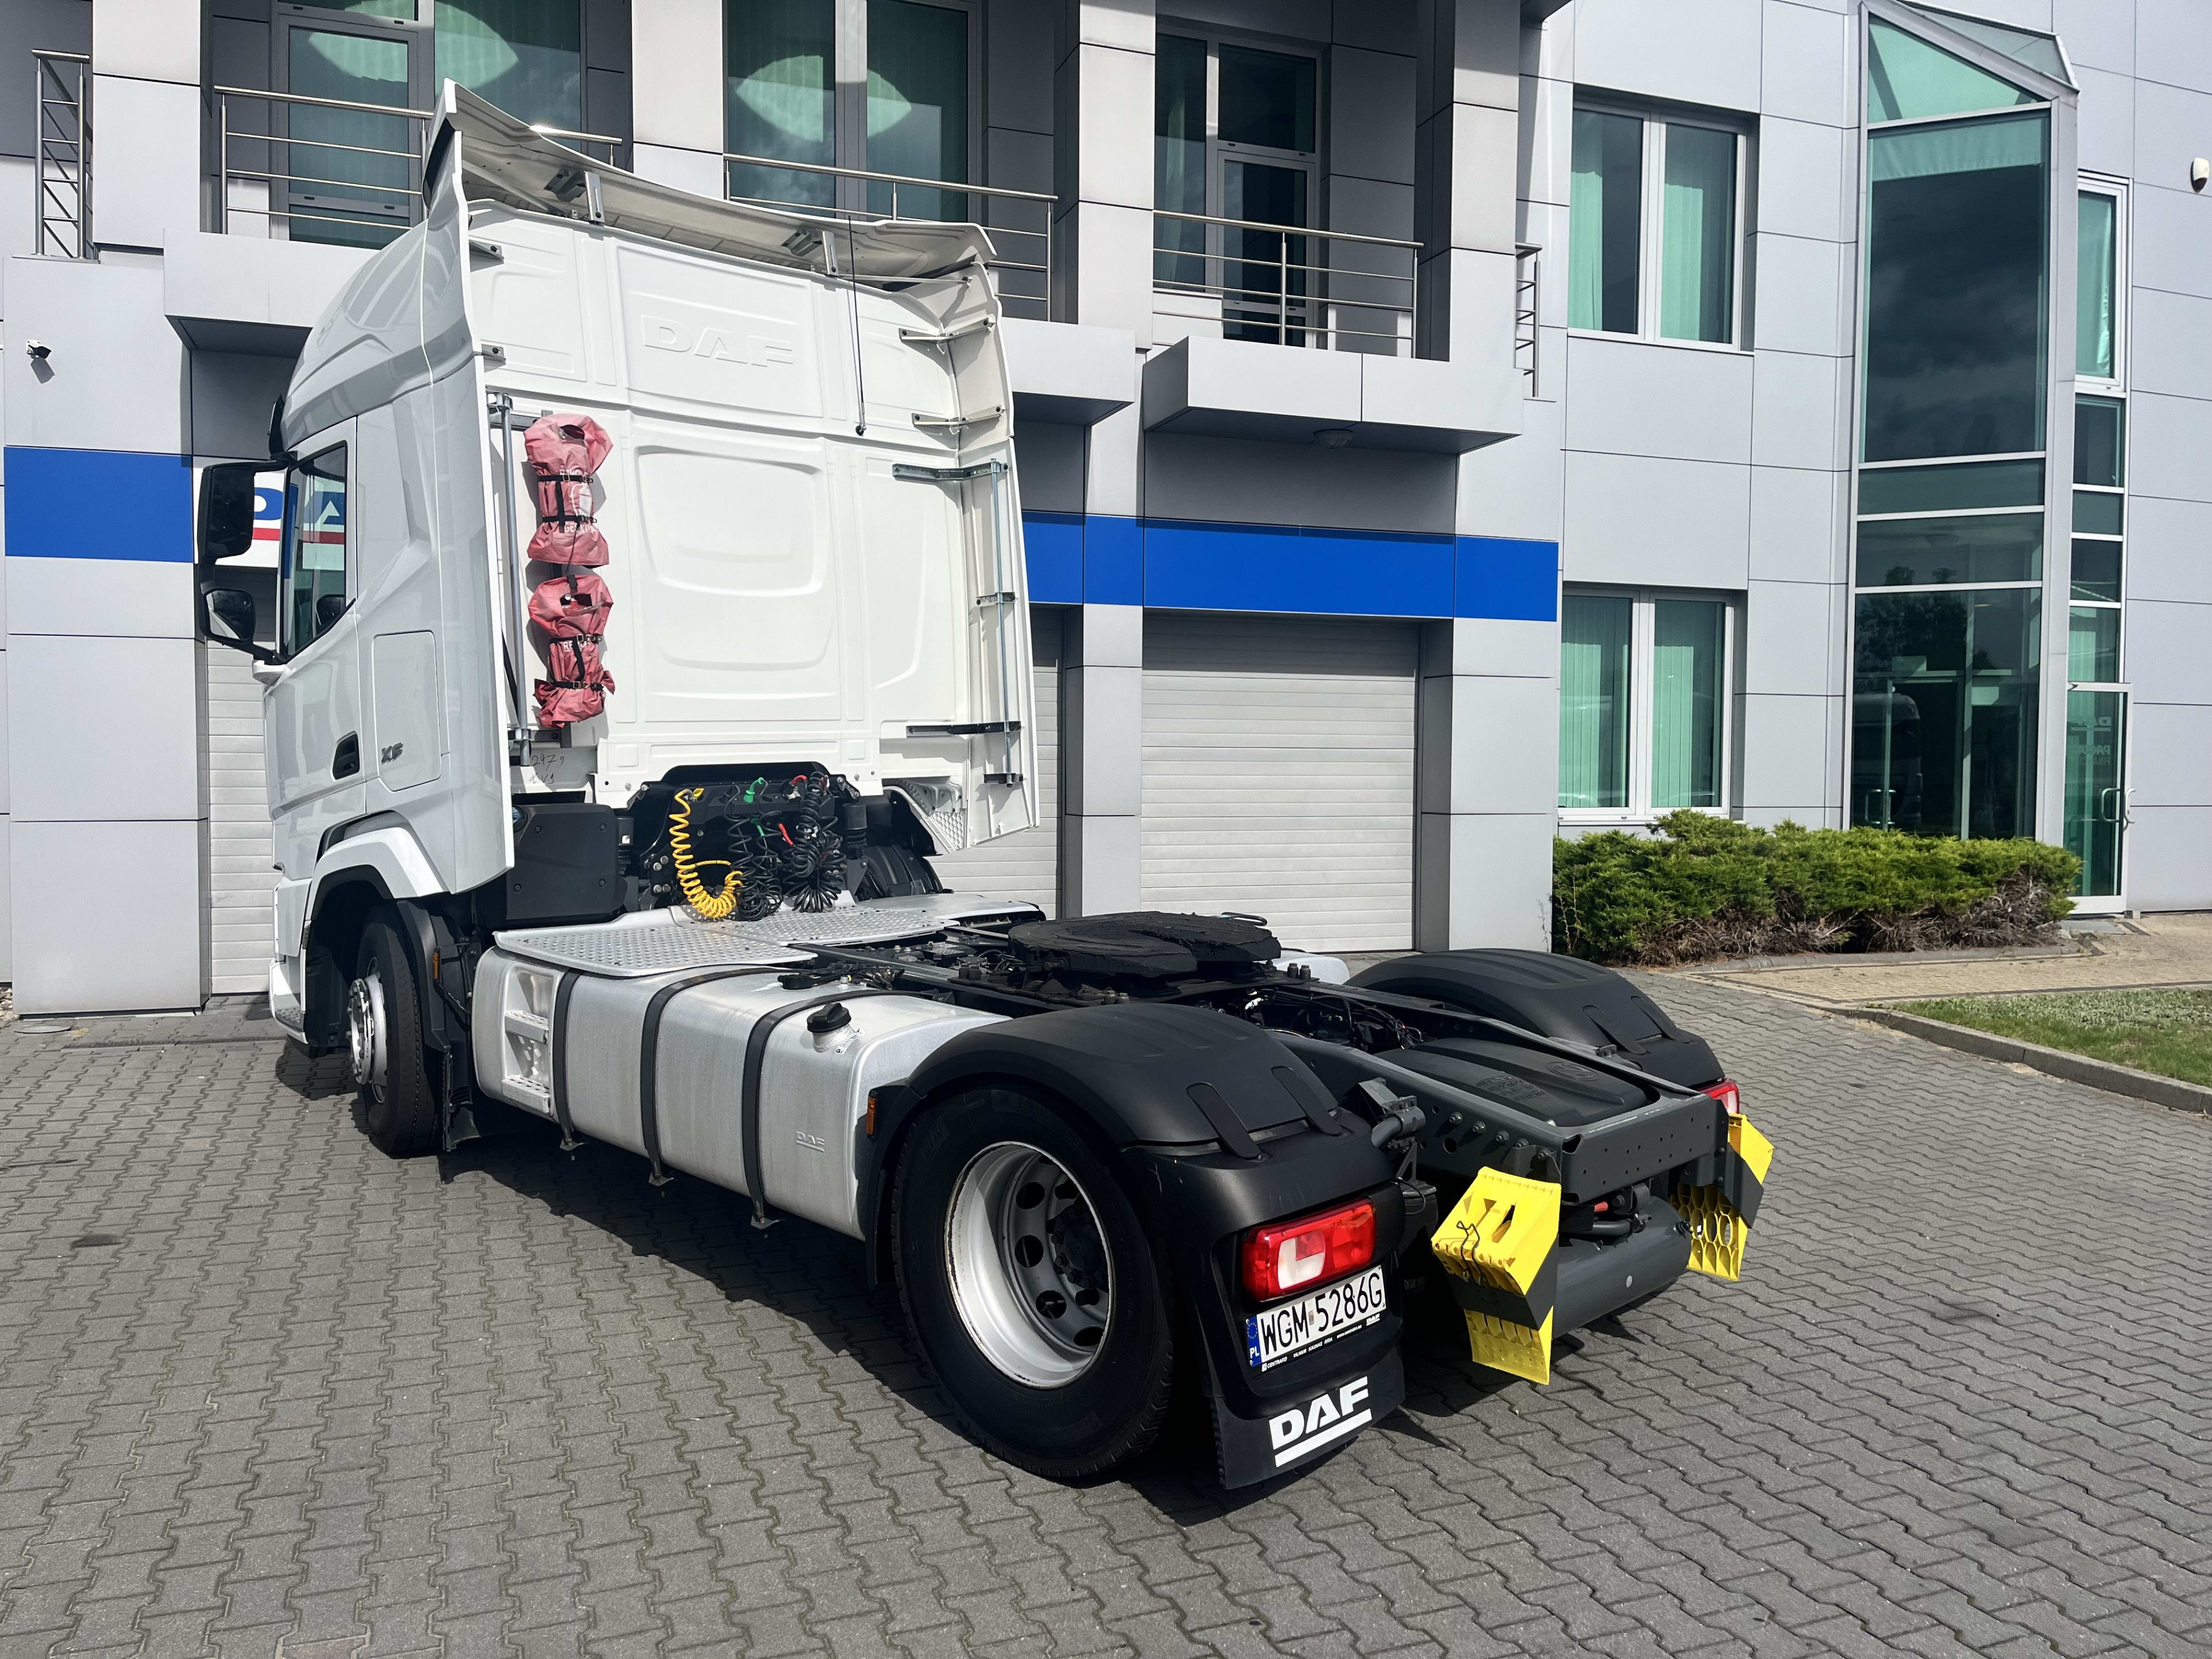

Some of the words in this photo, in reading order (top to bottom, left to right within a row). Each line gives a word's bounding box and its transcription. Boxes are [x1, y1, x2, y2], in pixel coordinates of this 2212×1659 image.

[641, 315, 794, 367] DAF
[381, 742, 403, 763] XF
[796, 1131, 825, 1147] DAF
[1260, 1301, 1309, 1355] WGM
[1315, 1272, 1382, 1332] 5286G
[1366, 1313, 1380, 1324] DAF
[1249, 1346, 1260, 1358] PL
[1269, 1376, 1369, 1450] DAF
